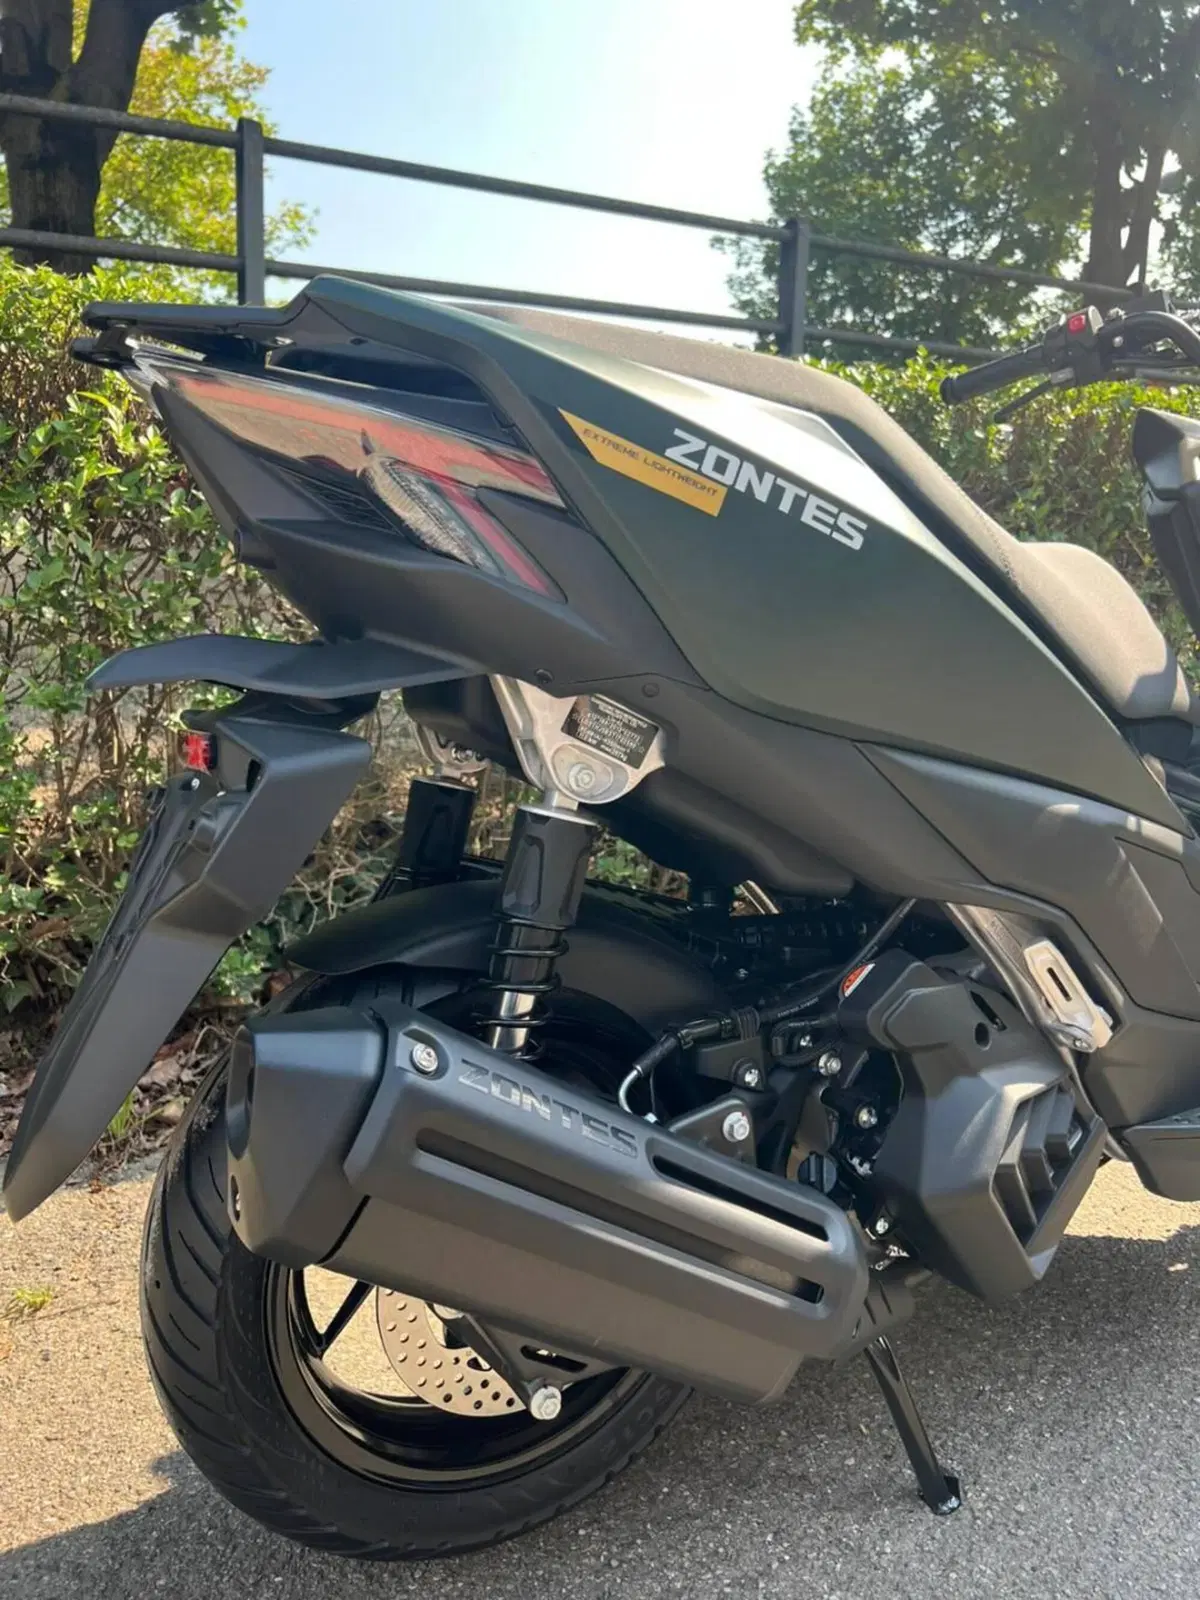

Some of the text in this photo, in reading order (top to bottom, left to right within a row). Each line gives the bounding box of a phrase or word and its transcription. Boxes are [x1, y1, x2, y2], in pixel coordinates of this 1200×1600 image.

[583, 428, 719, 498] EXTREME LIGHTWEIGHT
[664, 428, 868, 551] ZONTES
[458, 1058, 639, 1159] ZONTES
